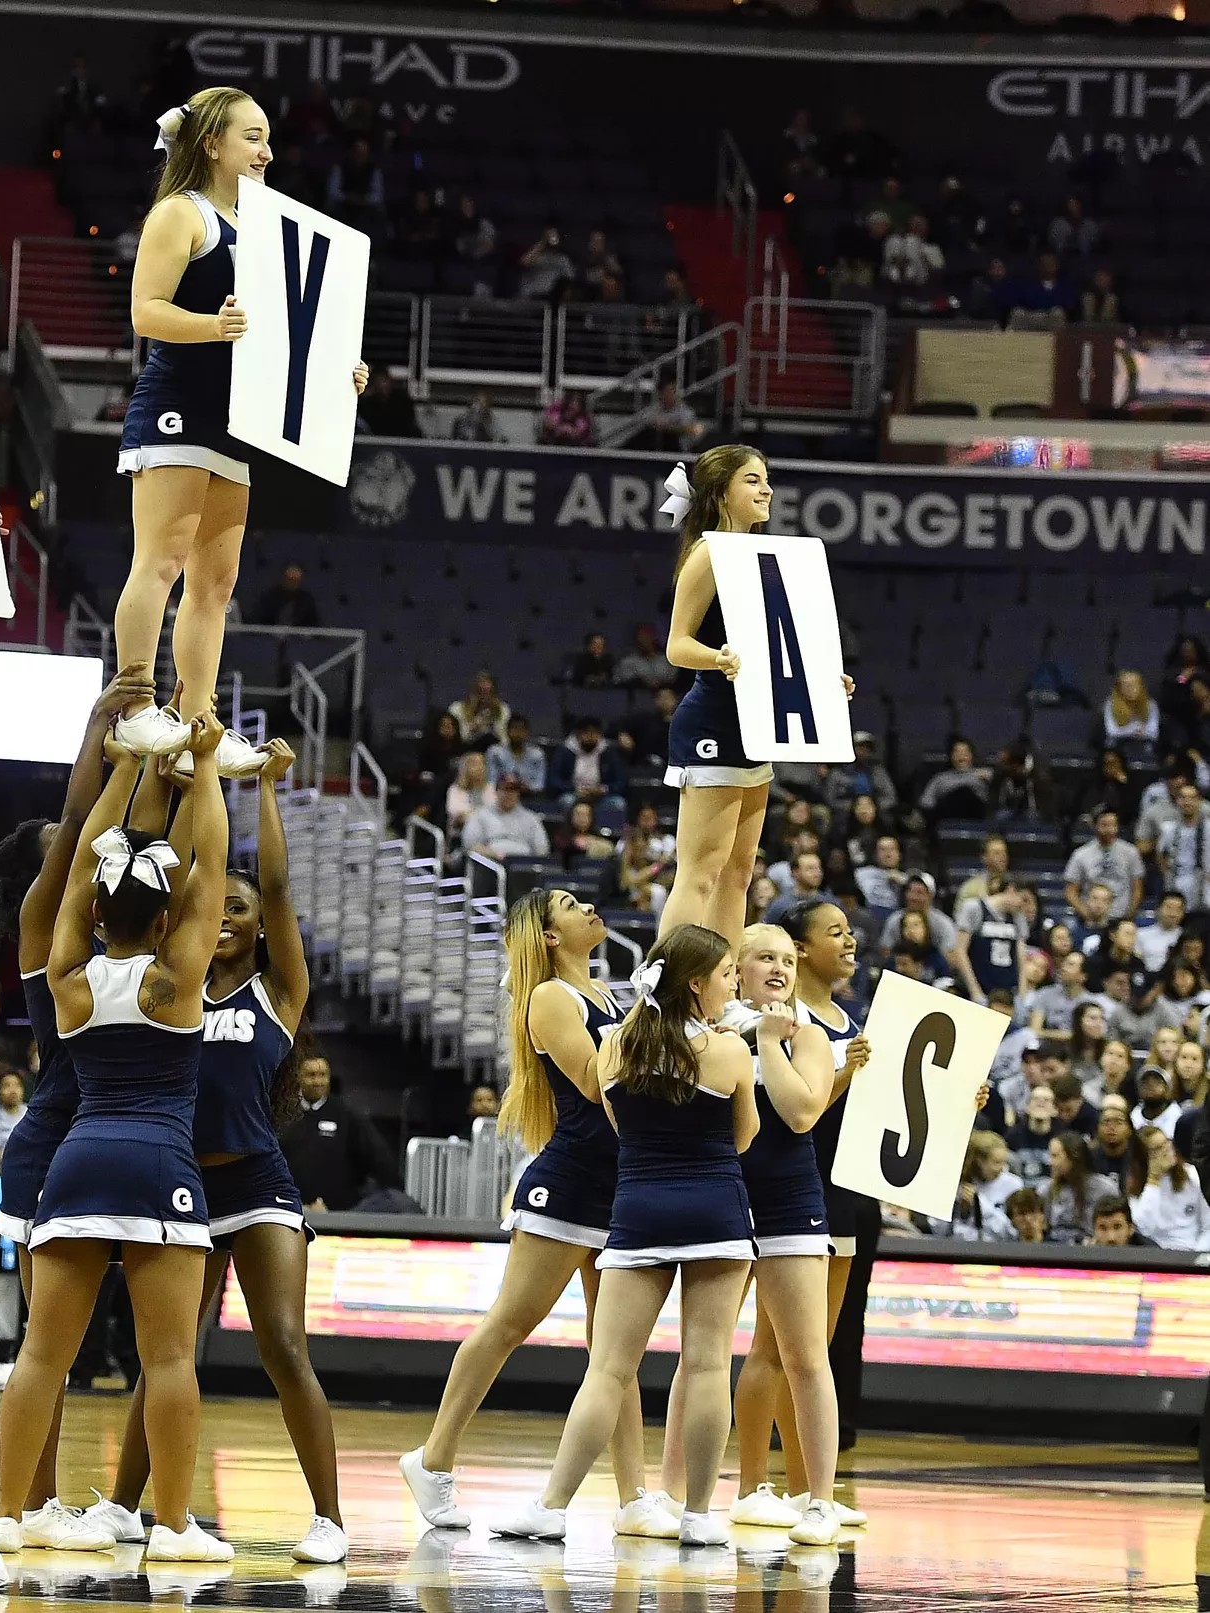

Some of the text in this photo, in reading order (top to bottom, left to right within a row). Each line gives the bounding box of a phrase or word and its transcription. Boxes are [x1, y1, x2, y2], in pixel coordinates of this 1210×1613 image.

[188, 29, 522, 91] ETIHAD
[281, 215, 330, 446] Y
[158, 411, 183, 435] G
[436, 464, 537, 525] WE
[758, 553, 818, 745] A
[695, 738, 719, 759] G
[880, 1012, 956, 1187] S
[172, 1187, 194, 1213] G
[528, 1186, 550, 1208] G
